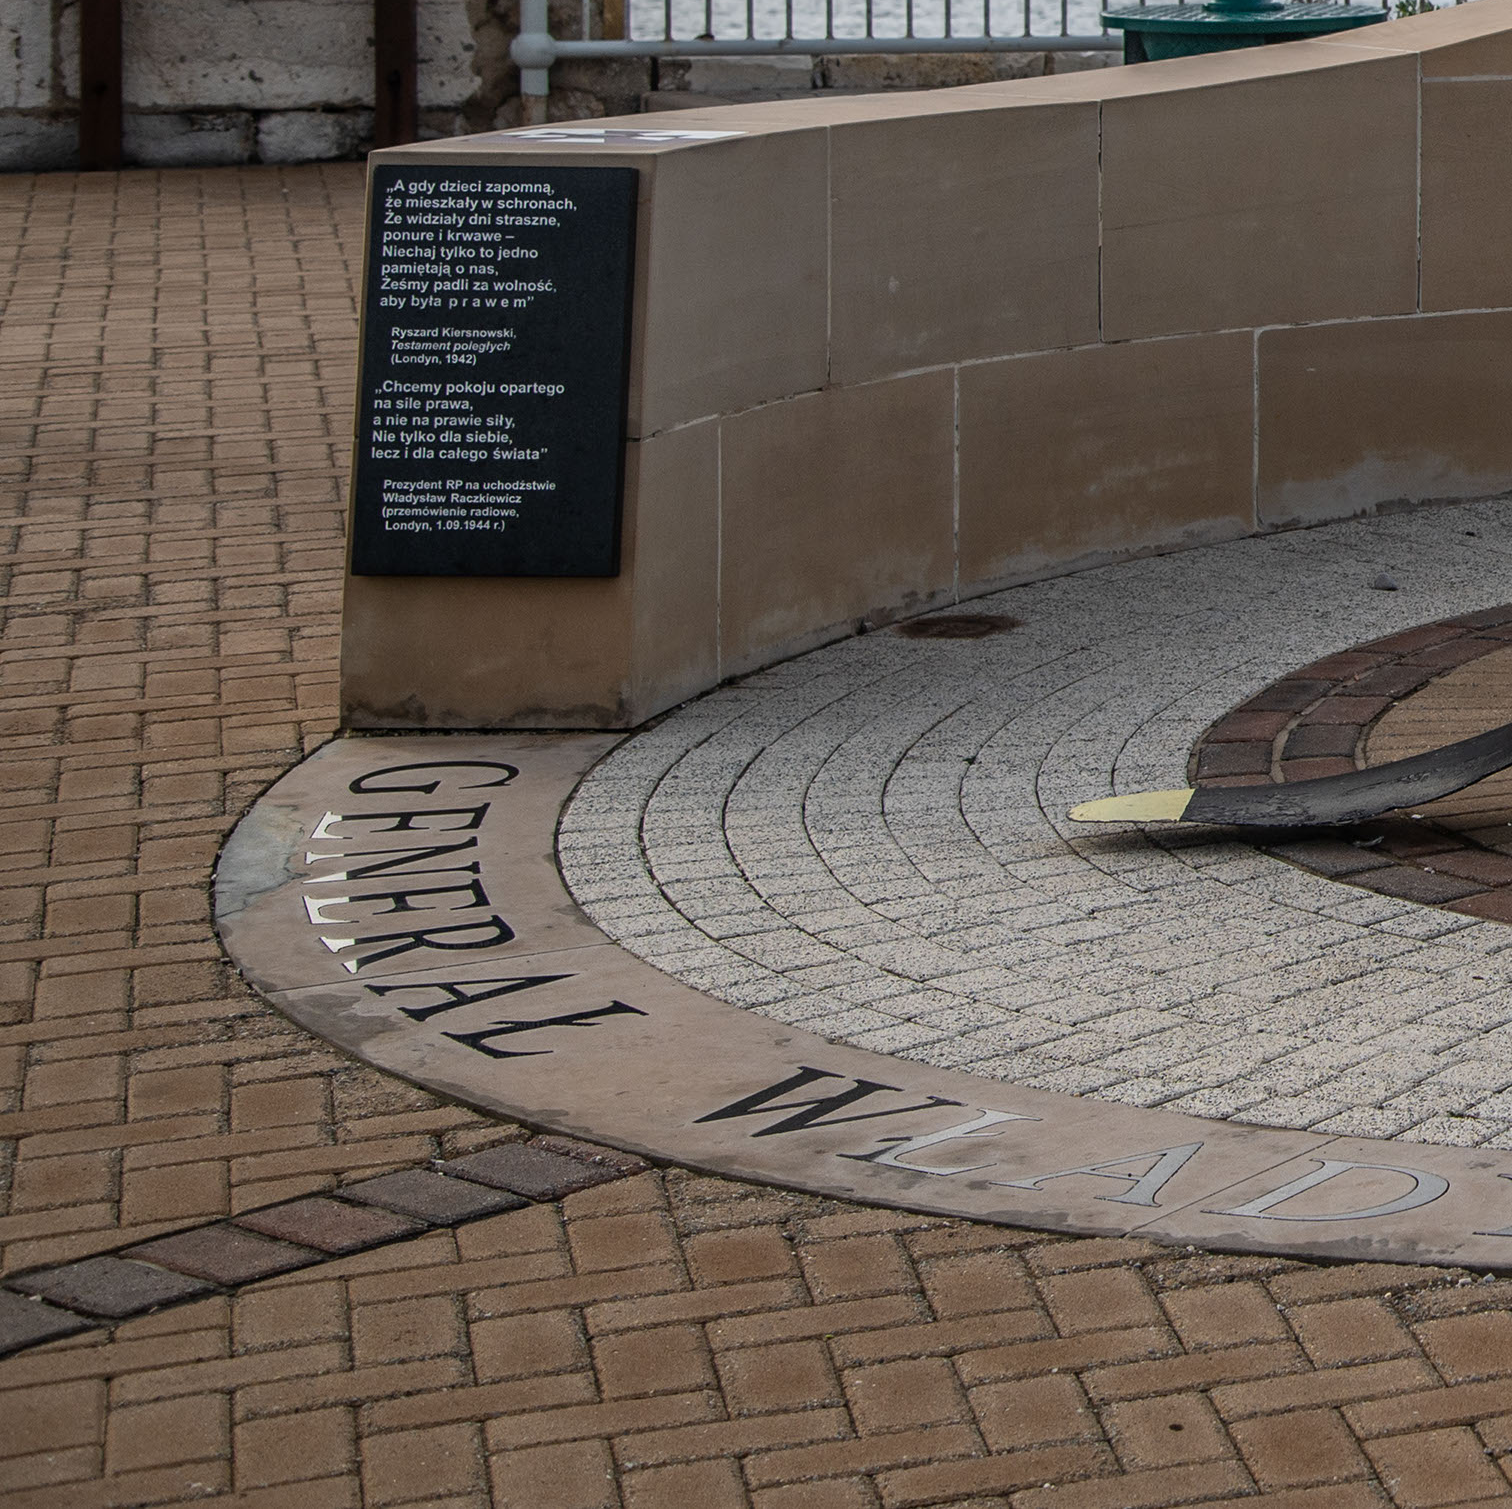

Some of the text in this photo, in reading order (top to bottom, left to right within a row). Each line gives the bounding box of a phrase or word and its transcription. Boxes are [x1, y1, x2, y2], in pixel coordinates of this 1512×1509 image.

[386, 178, 555, 196] „A gdy dzieci zapomną,
[384, 194, 577, 212] że mieszkały w schronach,
[383, 210, 561, 228] Że widziały dni straszne,
[380, 261, 499, 278] pamiętają o nas,
[379, 277, 557, 293] Żeśmy padli za wolność,
[390, 326, 517, 339] Ryszard Kiersnowski,
[390, 352, 477, 366] (Londyn, 1942)
[374, 379, 565, 397] „Chcemy pokoju opartego
[371, 429, 513, 445] Nie tylko dla siebie,
[382, 491, 522, 505] Władysław Raczkiewicz
[384, 519, 505, 533] Londyn, 1.09.1944 r.)
[303, 760, 648, 1059] GENERAŁ
